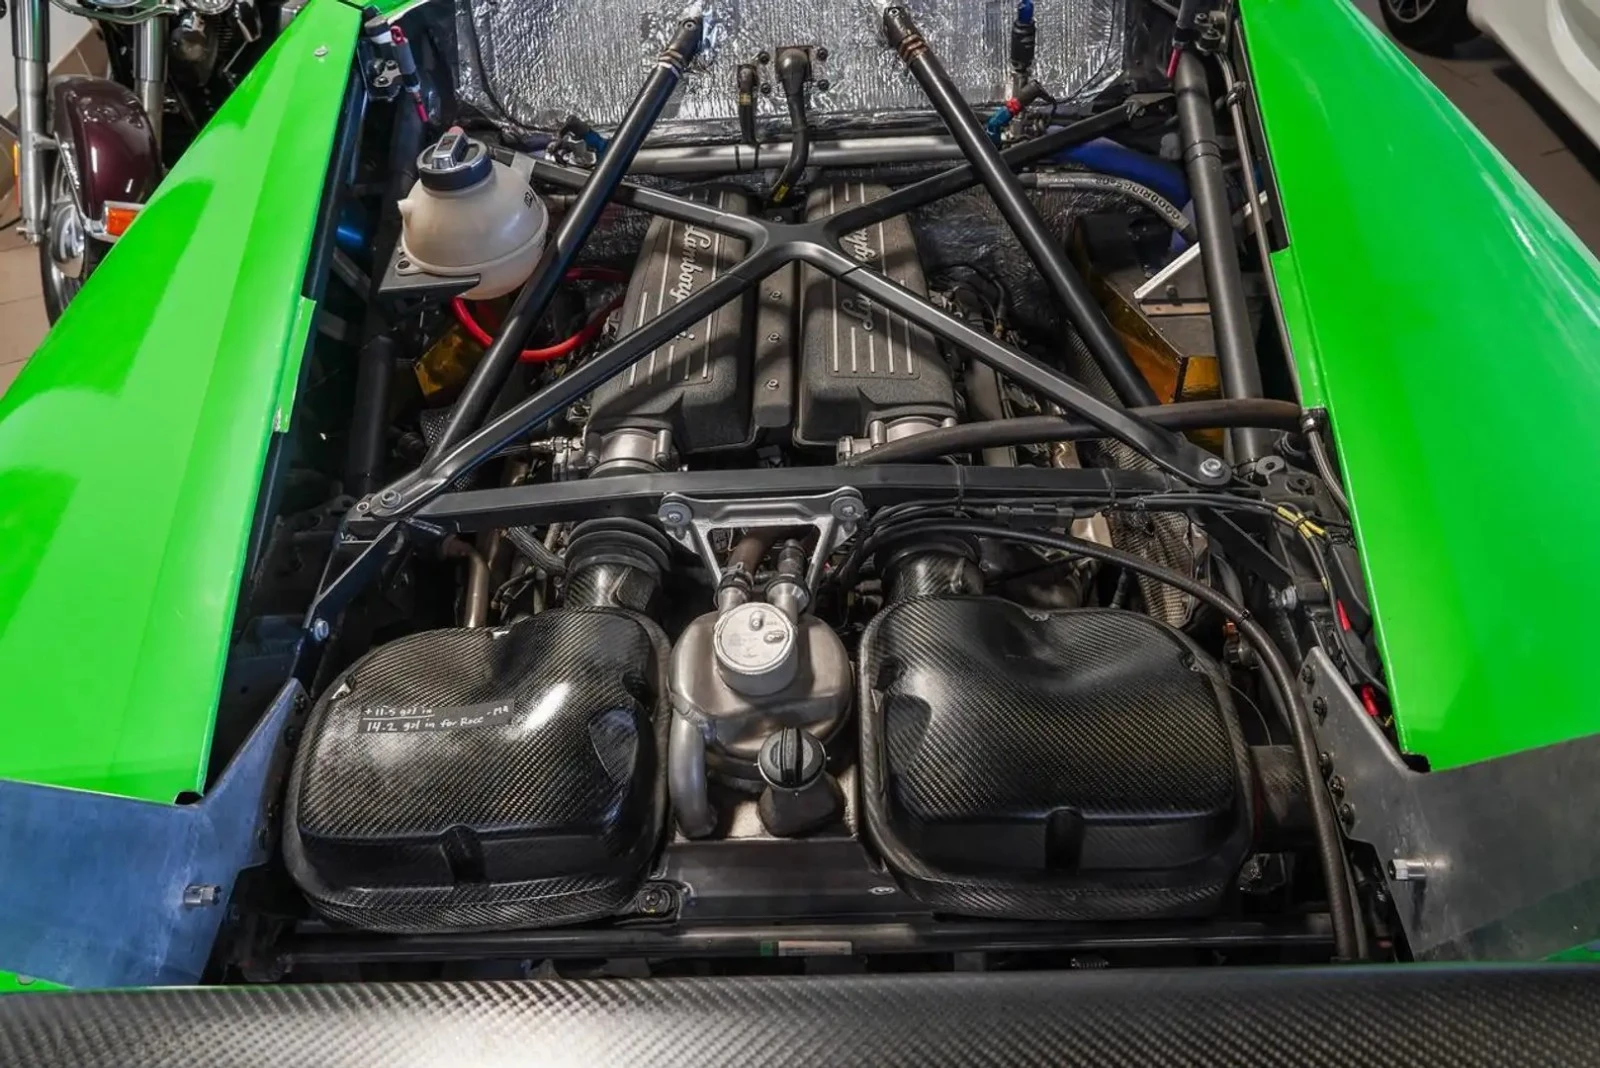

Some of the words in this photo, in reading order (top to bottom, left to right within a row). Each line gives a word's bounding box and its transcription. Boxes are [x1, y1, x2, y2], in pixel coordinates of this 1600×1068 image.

[366, 721, 398, 732] 14.2
[402, 720, 420, 732] gal
[424, 718, 435, 728] in
[439, 718, 457, 728] for
